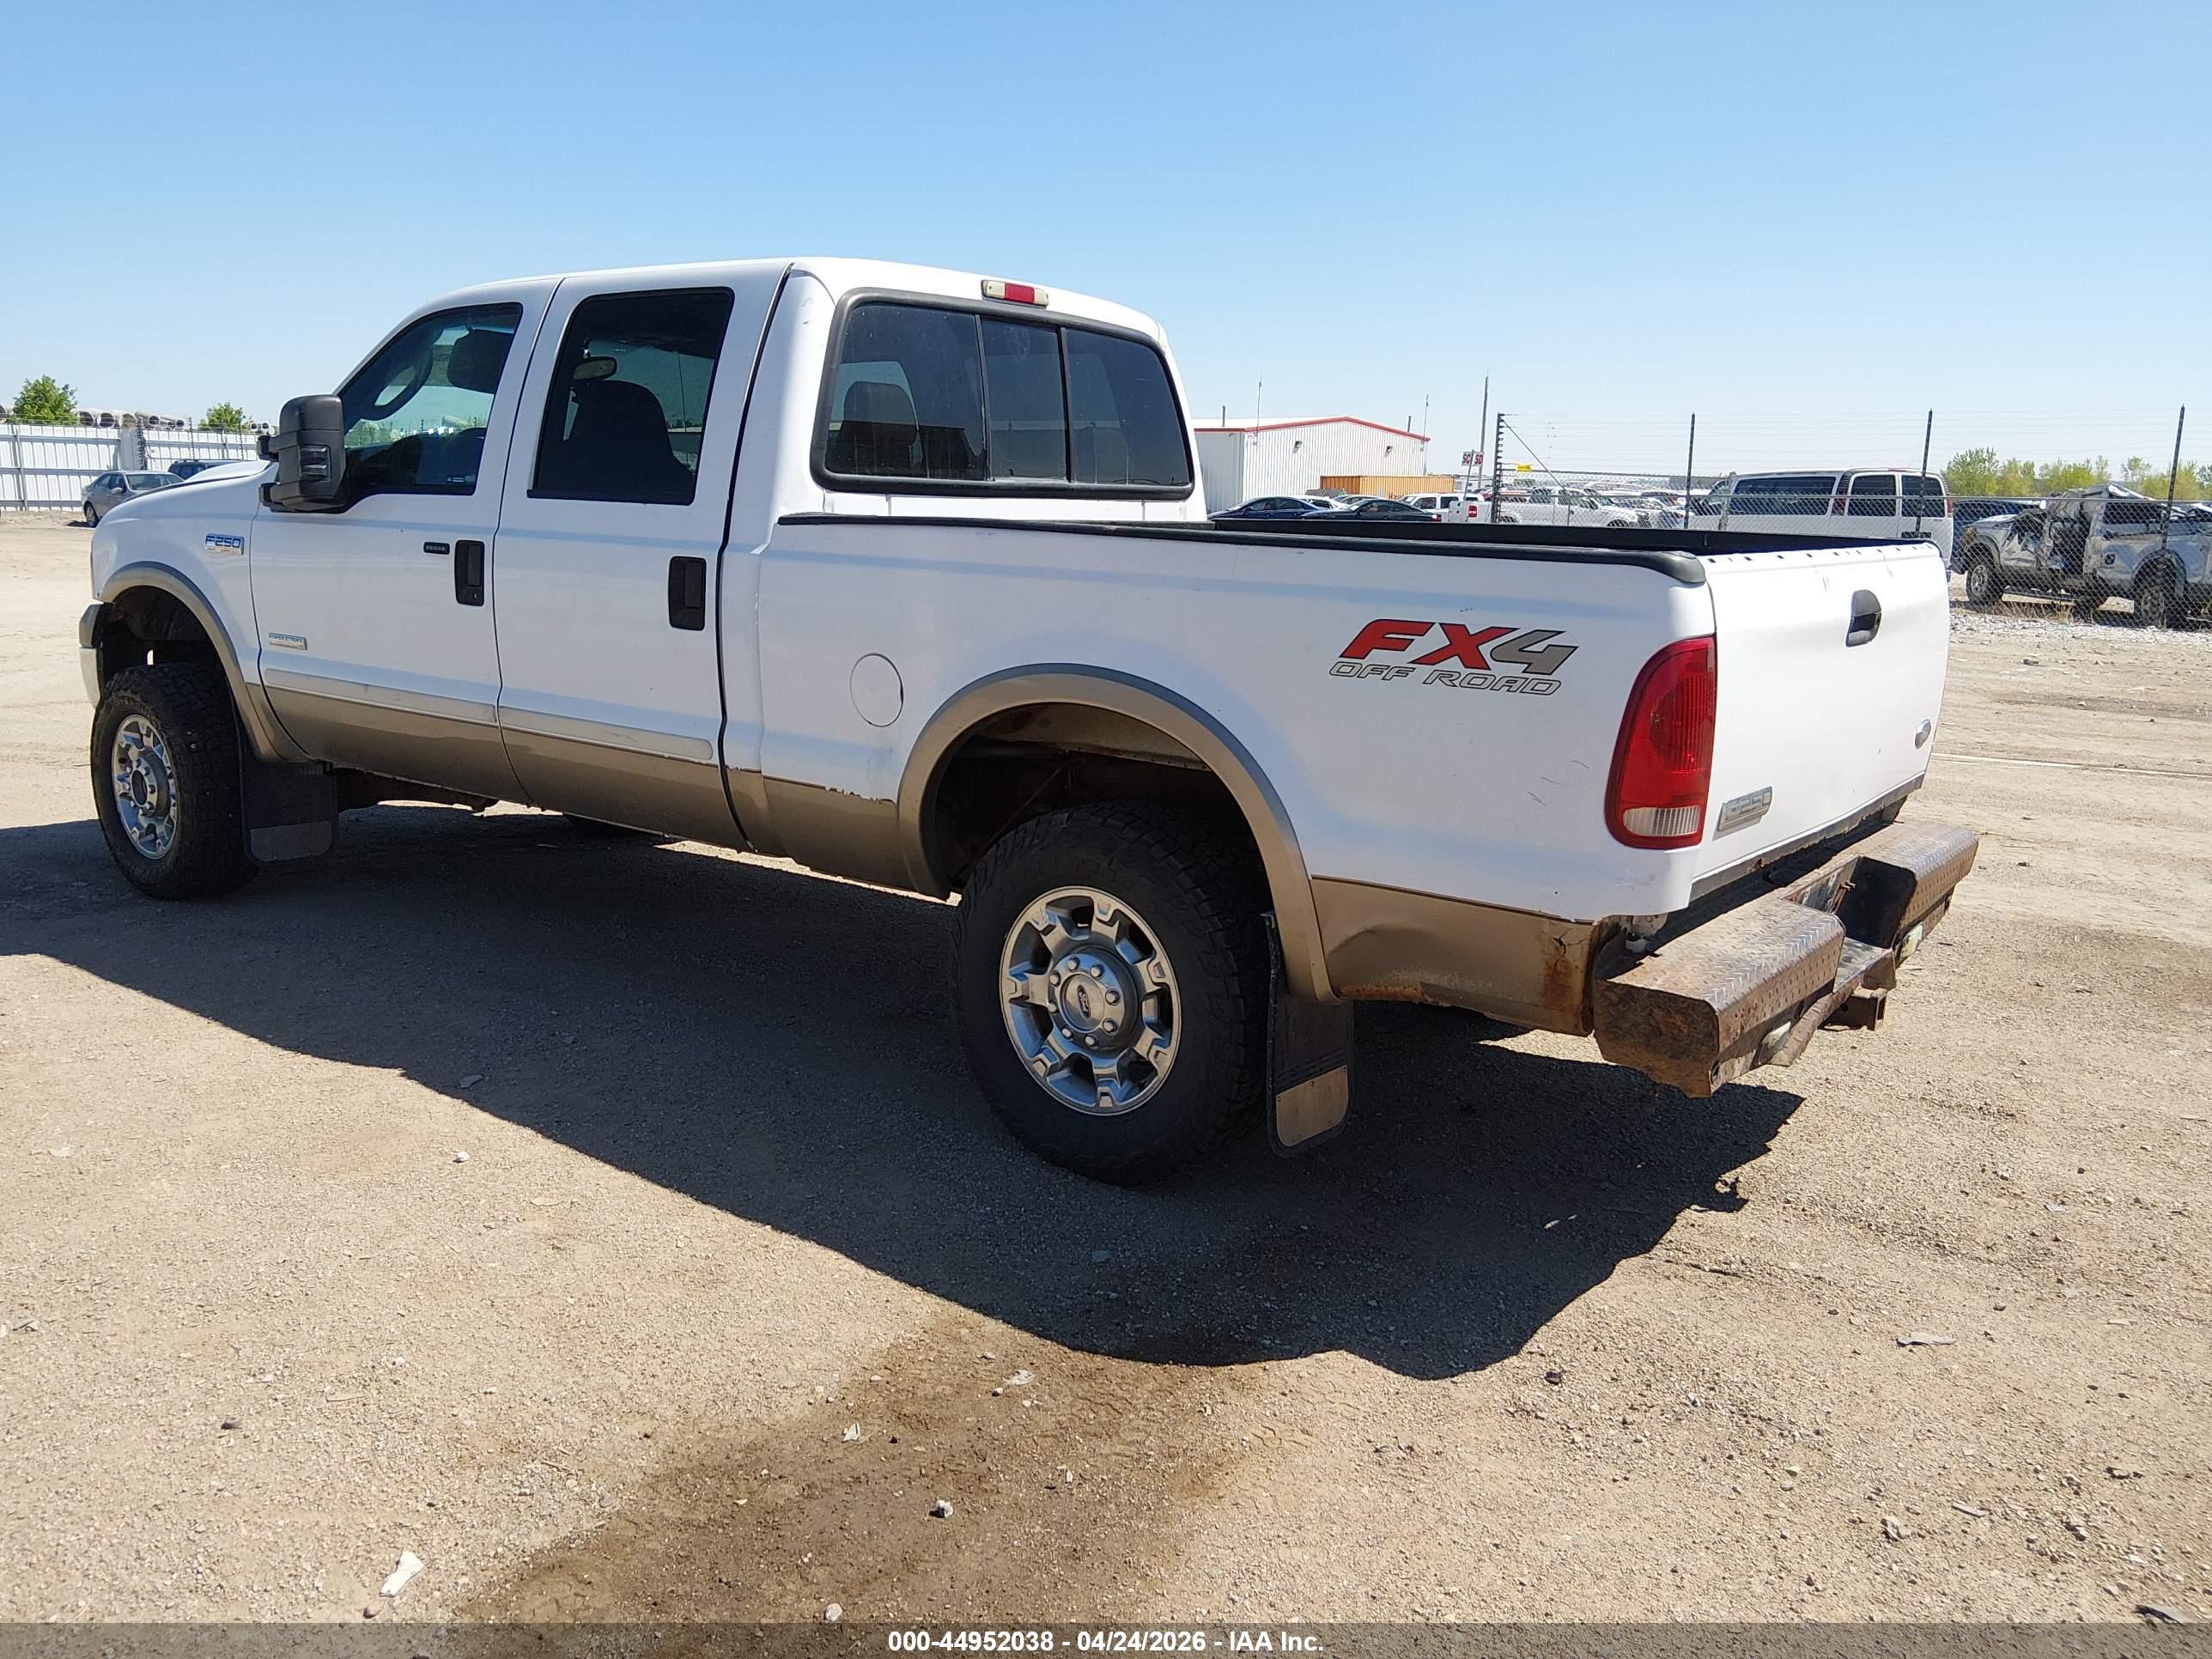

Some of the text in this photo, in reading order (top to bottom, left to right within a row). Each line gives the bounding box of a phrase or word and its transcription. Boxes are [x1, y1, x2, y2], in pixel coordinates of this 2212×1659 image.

[1462, 453, 1471, 465] SC
[1474, 453, 1484, 465] SD
[1339, 618, 1580, 676] FX4
[1329, 660, 1562, 696] OFF ROAD
